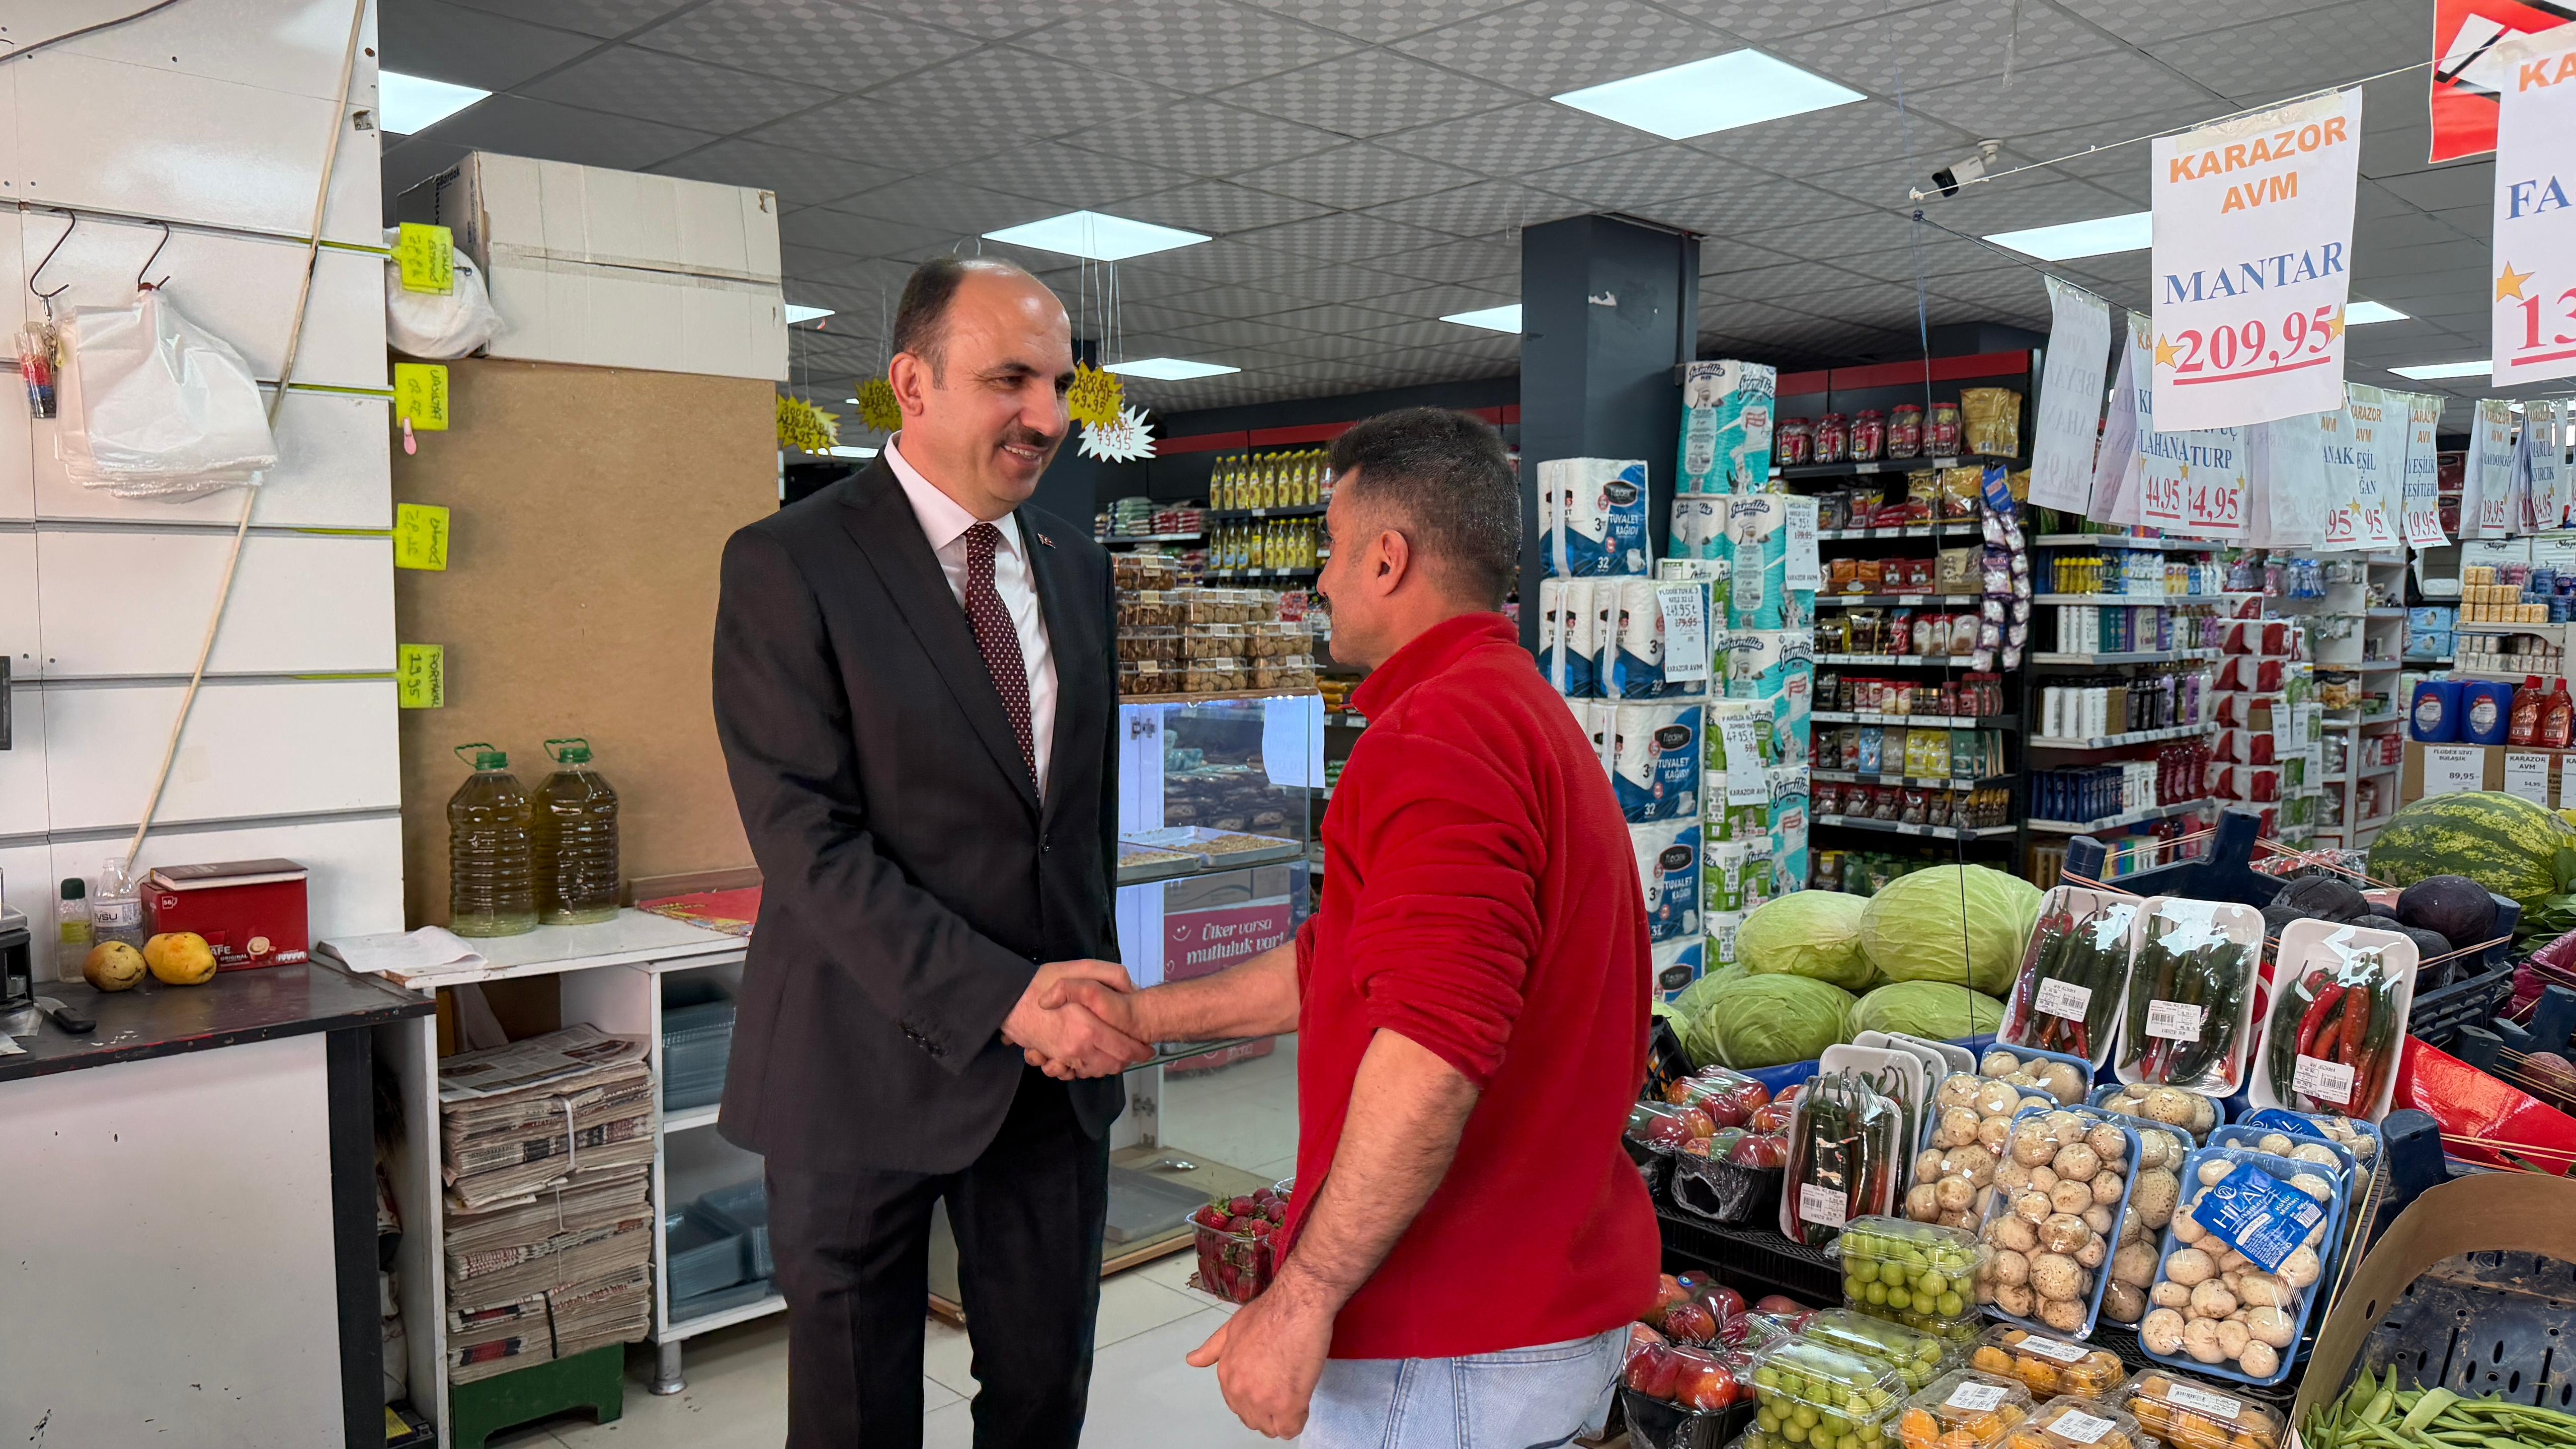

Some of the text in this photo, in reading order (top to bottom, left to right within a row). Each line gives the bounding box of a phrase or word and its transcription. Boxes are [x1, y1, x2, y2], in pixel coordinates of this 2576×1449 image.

[2170, 116, 2348, 184] KARAZOR
[2221, 171, 2298, 214] AVM
[2162, 242, 2344, 305] MANTAR
[2174, 304, 2333, 374] 209,95
[2356, 428, 2372, 442] AVM
[2140, 430, 2189, 461] LAHANA
[2190, 446, 2232, 469] TURP
[2323, 446, 2355, 464] ANAK
[2357, 449, 2376, 473] EŞİL
[2146, 475, 2180, 511] 44,95
[2359, 476, 2376, 494] ĞAN
[1594, 517, 1601, 531] 3
[1610, 514, 1638, 524] TUVALET
[2366, 509, 2383, 534] 95
[1598, 556, 1609, 569] 32
[1650, 639, 1658, 654] 3
[1643, 763, 1649, 778] 3
[1657, 756, 1690, 769] TUVALET
[2449, 772, 2474, 780] 89,95
[1644, 802, 1656, 815] 32
[1649, 887, 1656, 901] 3
[1202, 918, 1272, 941] Ülker varsa
[1186, 931, 1283, 965] mutluluk var!
